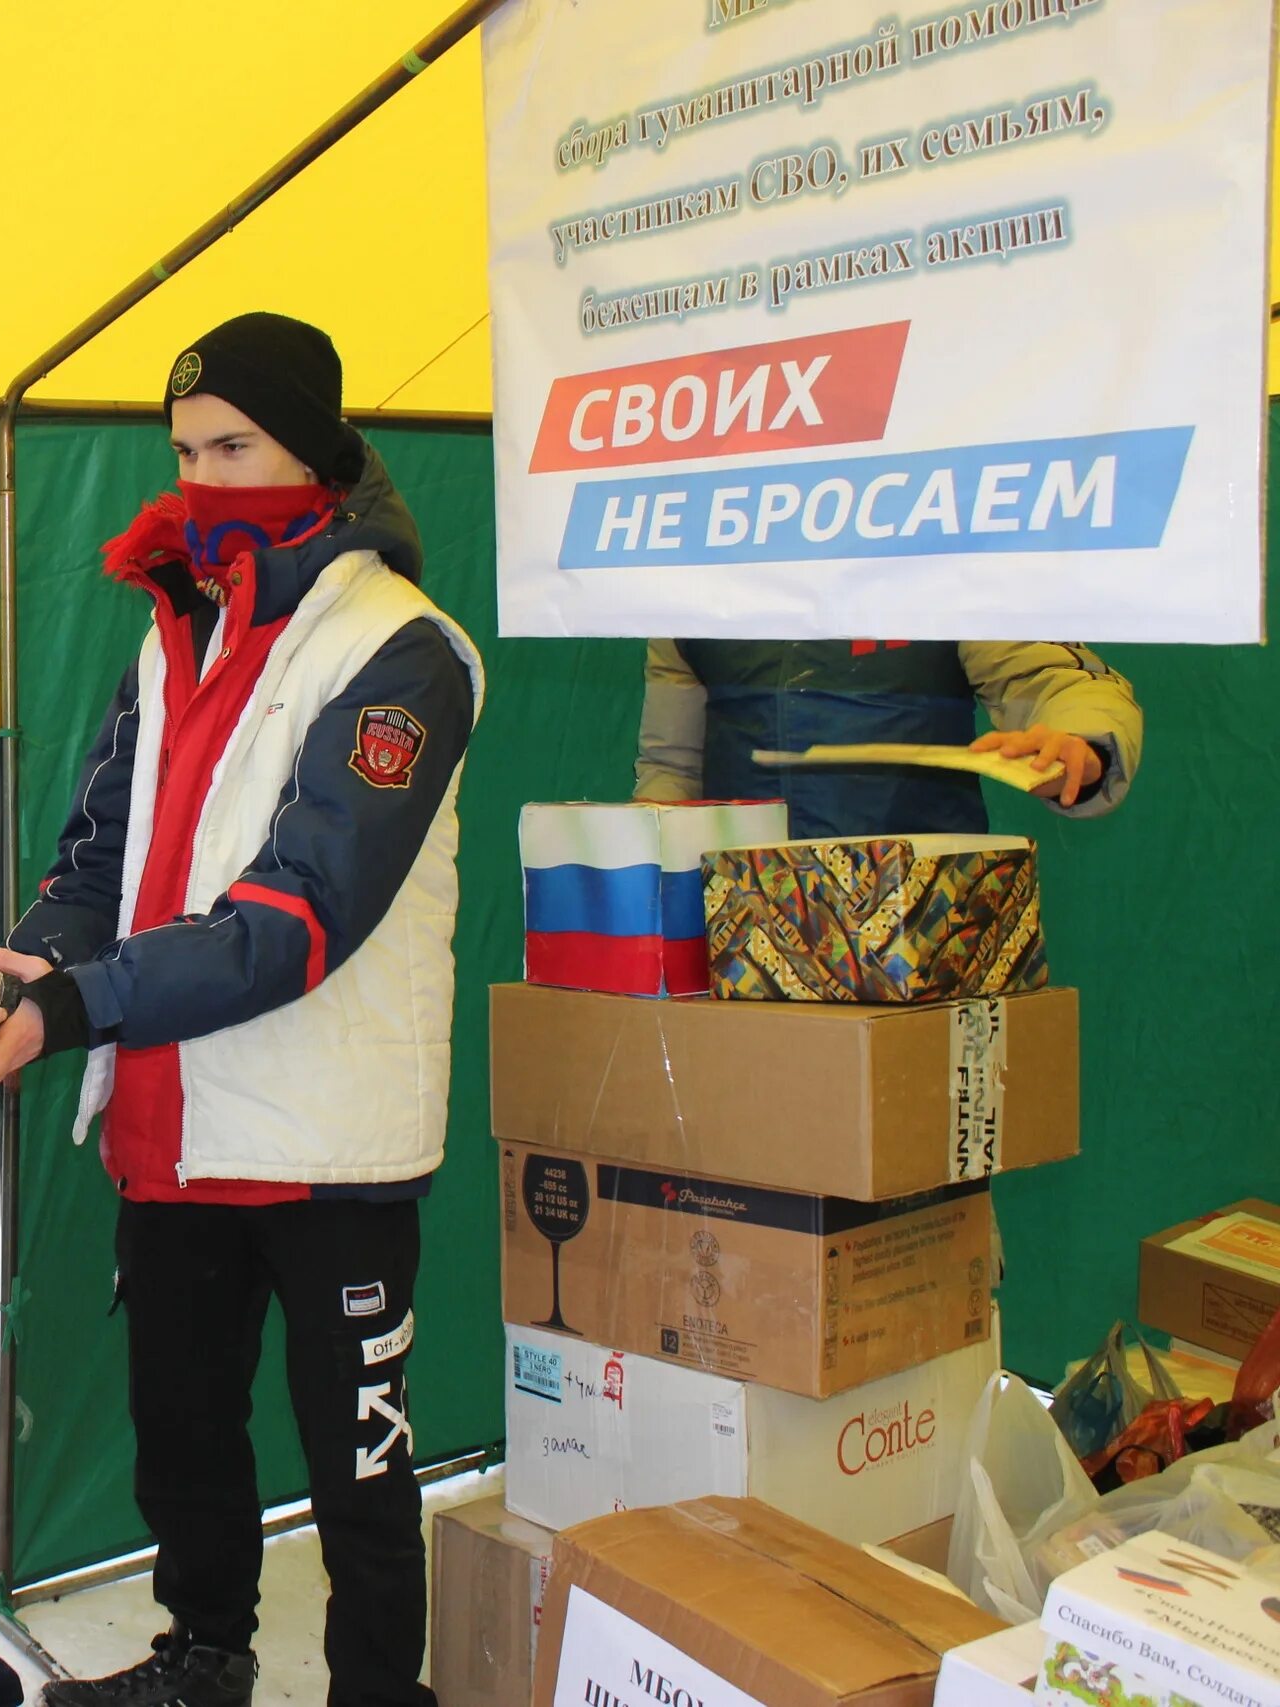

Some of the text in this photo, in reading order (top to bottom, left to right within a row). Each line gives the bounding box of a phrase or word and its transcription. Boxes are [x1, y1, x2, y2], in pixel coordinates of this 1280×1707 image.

[556, 0, 1099, 170] сбора гуманитарной помощ
[552, 87, 1105, 263] участникам СВО, их семьям,
[582, 204, 1066, 335] беженцам в рамках акции
[568, 354, 832, 452] СВОИХ
[594, 455, 1117, 552] НЕ БРОСАЕМ
[367, 722, 415, 751] RUSSIA
[556, 1194, 568, 1206] US
[557, 1207, 569, 1219] UK
[524, 1350, 558, 1367] STYLE 40
[663, 1332, 678, 1351] 12
[682, 1314, 729, 1336] ENOTECA
[837, 1400, 936, 1476] Conte
[1057, 1604, 1134, 1650] Спасибо
[1138, 1641, 1182, 1675] Вам,
